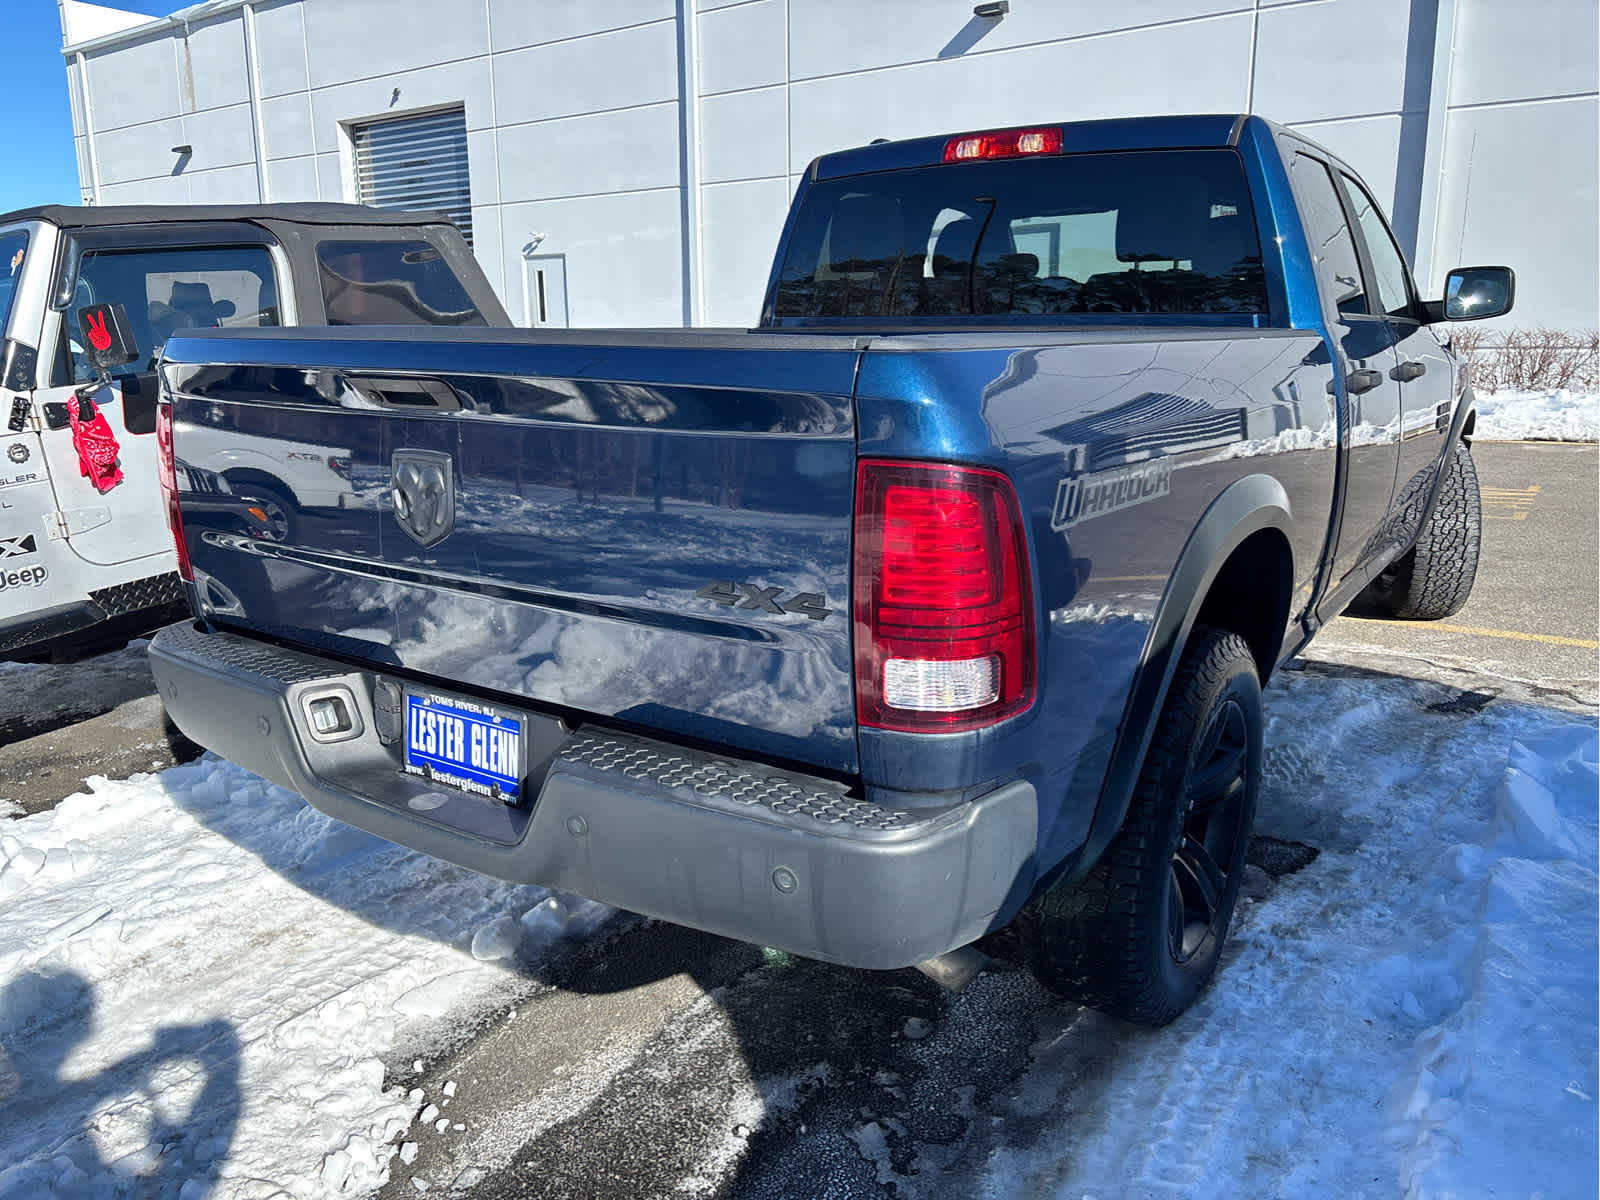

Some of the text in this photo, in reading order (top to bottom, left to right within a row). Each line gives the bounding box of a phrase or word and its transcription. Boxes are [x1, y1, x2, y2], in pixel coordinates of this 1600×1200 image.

[430, 694, 453, 708] TOMS
[411, 707, 519, 779] LESTER GLENN
